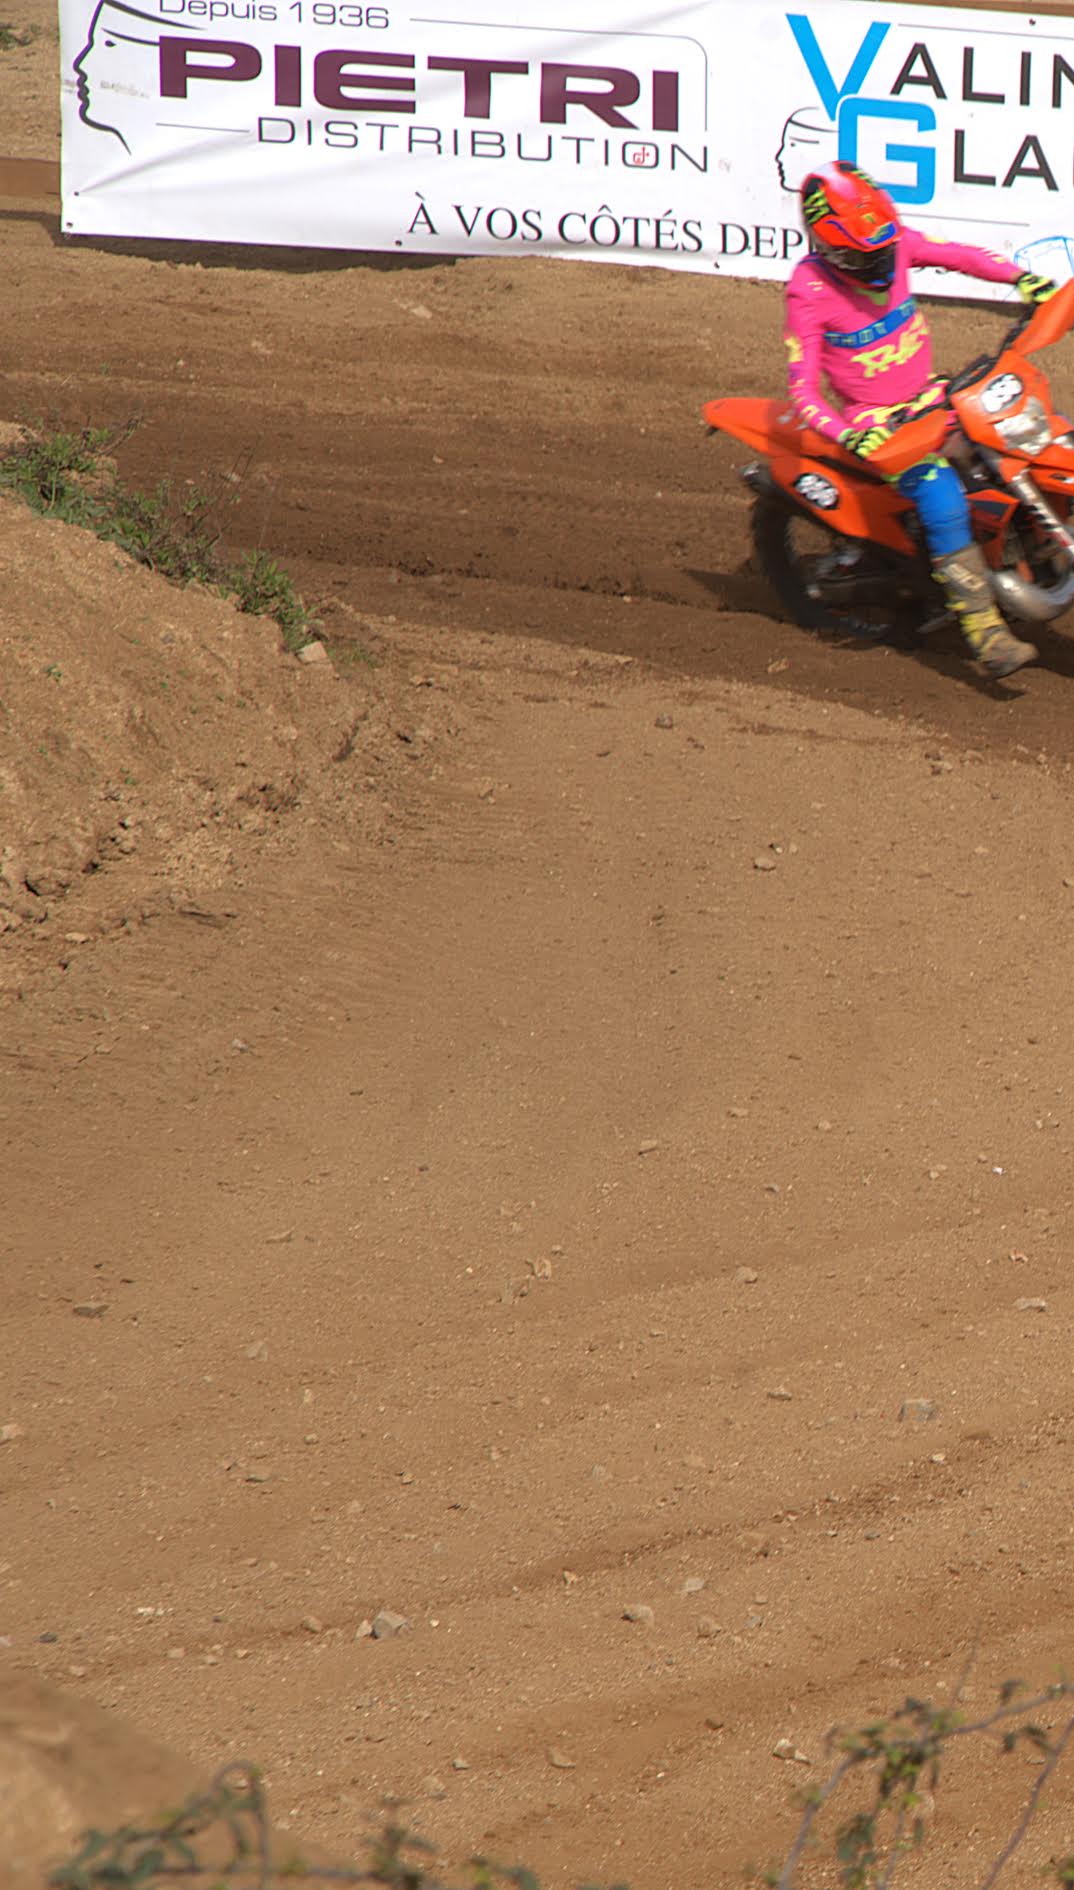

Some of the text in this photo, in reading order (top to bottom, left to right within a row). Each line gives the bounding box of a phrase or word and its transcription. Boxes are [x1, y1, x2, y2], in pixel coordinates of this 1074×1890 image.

[158, 0, 389, 29] Depuis 1936
[158, 35, 680, 133] PIETRI
[257, 116, 708, 173] DISTRIBUTION
[408, 191, 813, 259] À VOS CÔTÉS DEP
